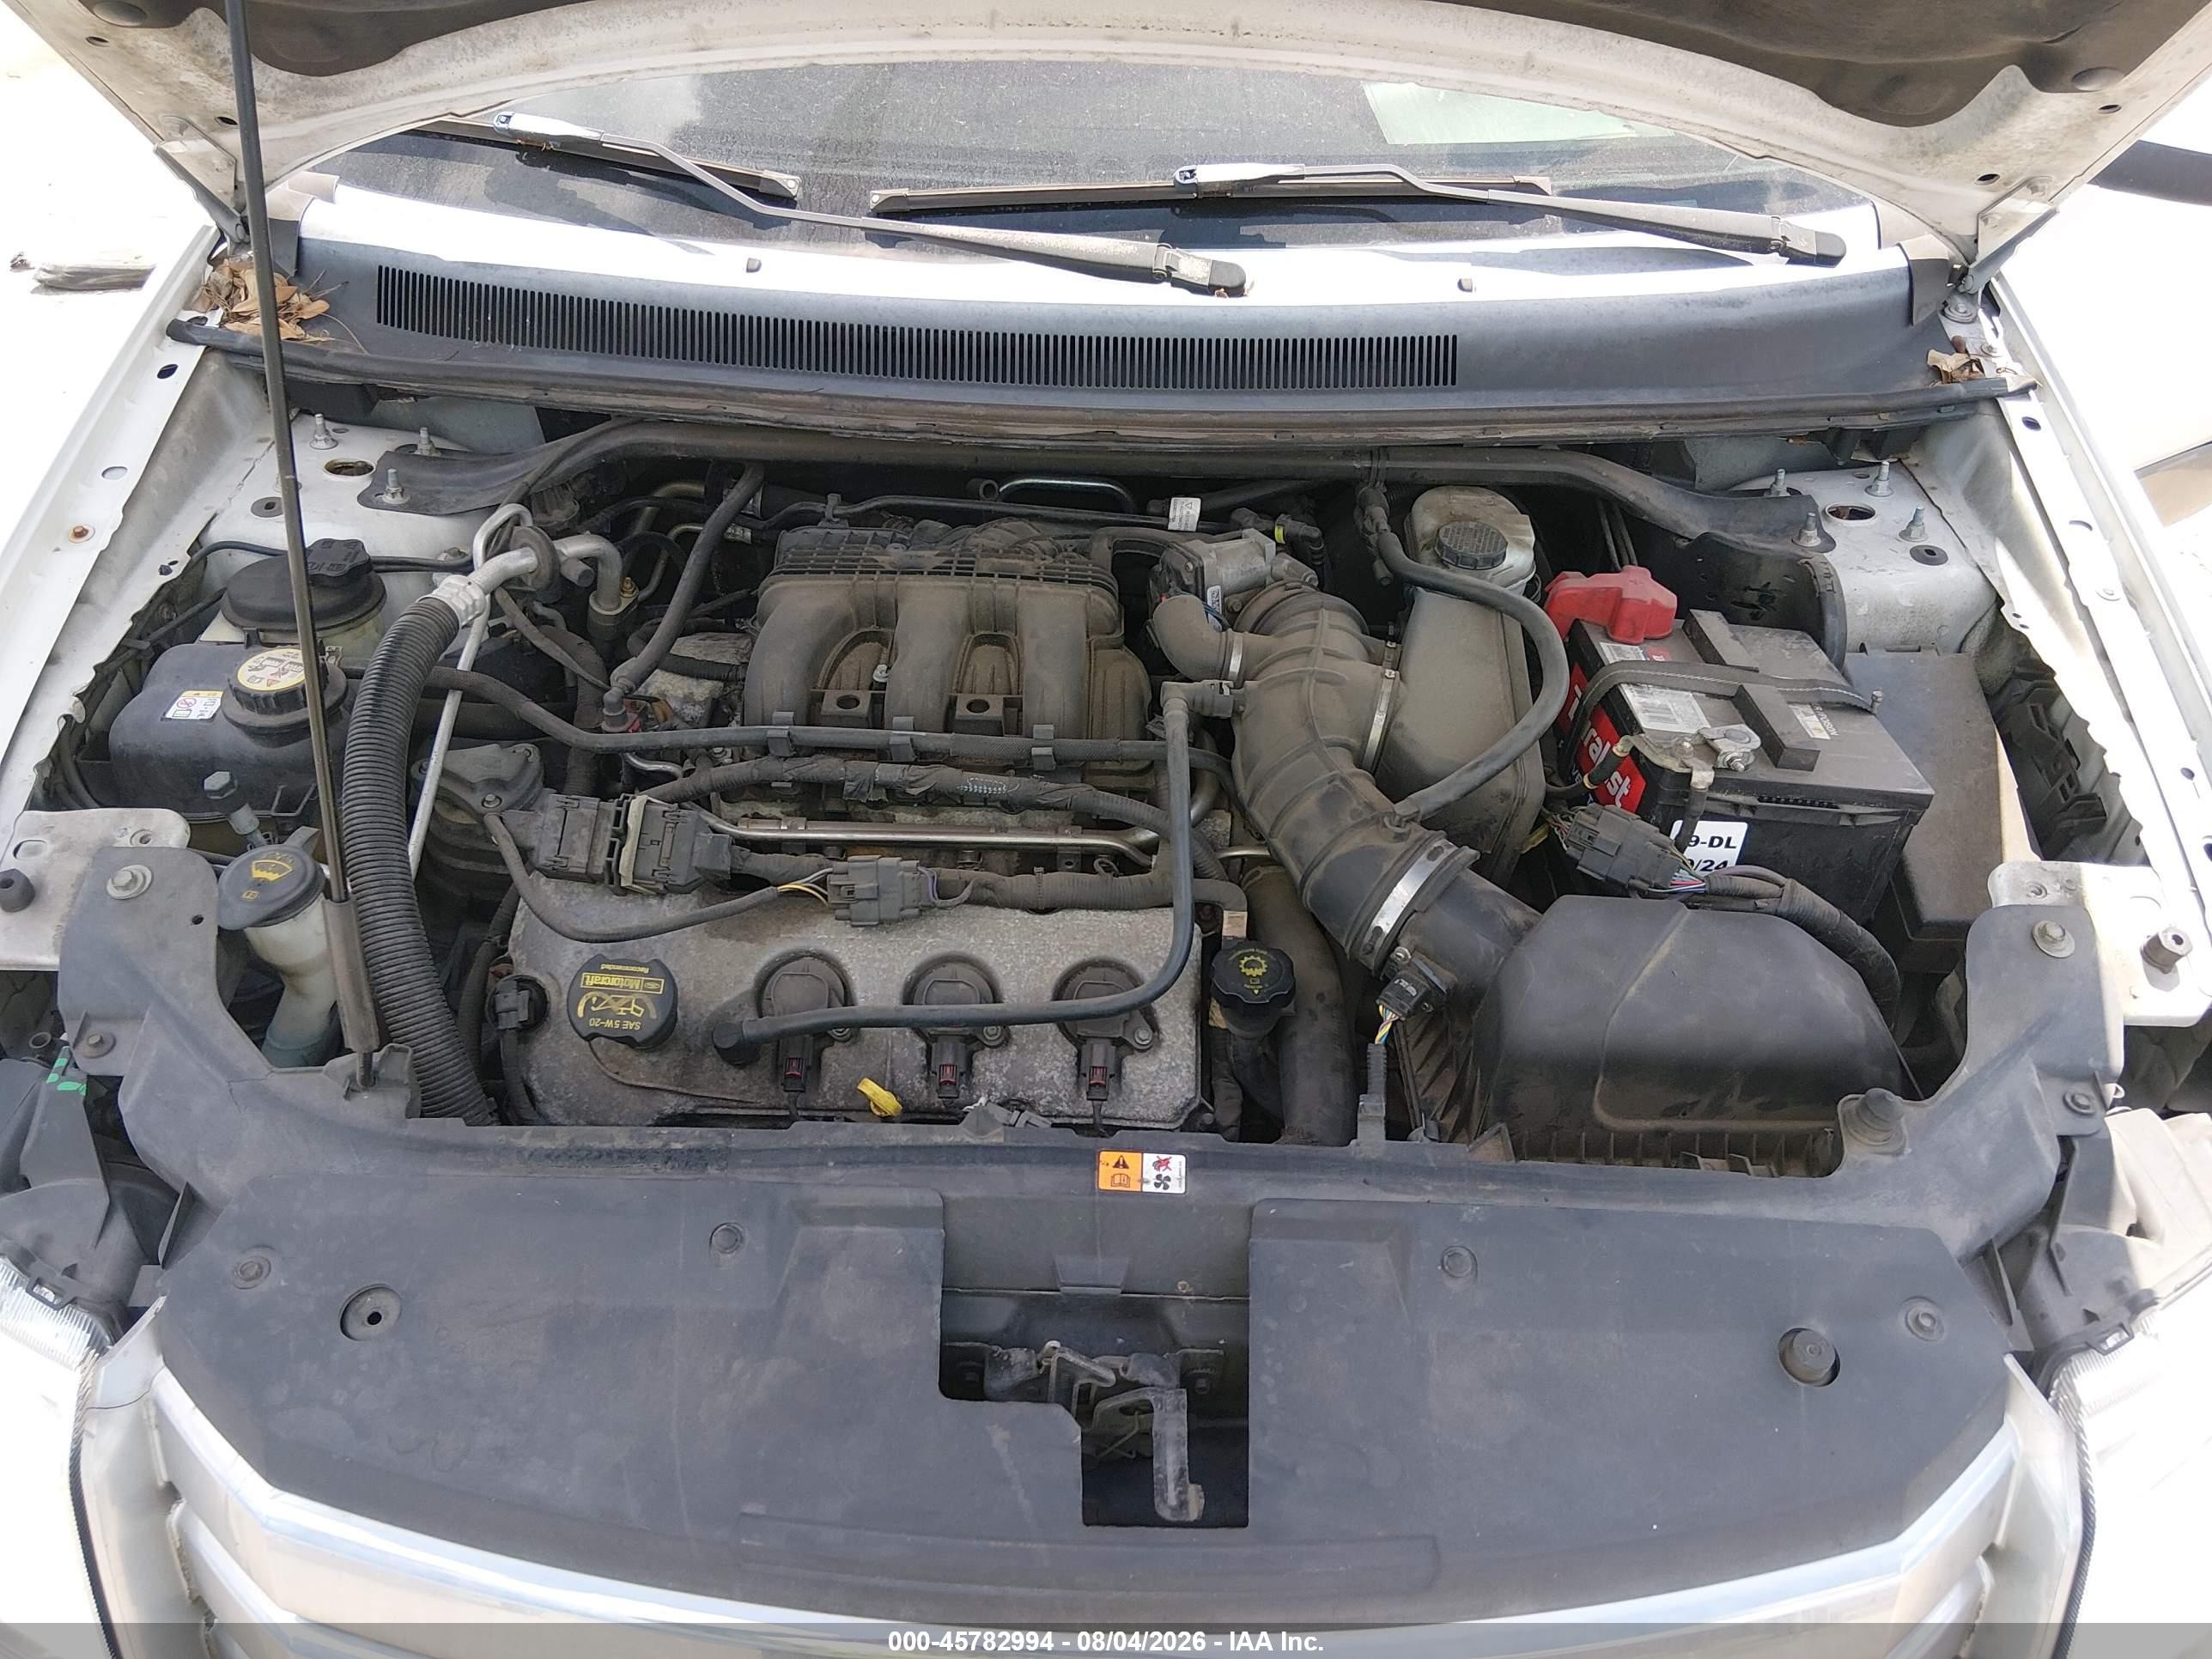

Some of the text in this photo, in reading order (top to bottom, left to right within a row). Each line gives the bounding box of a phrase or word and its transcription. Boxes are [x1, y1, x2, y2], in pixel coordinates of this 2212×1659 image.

[1686, 835, 1738, 849] 9-DL
[586, 975, 641, 989] Motorcraft
[589, 1018, 641, 1030] SAE 5W-20
